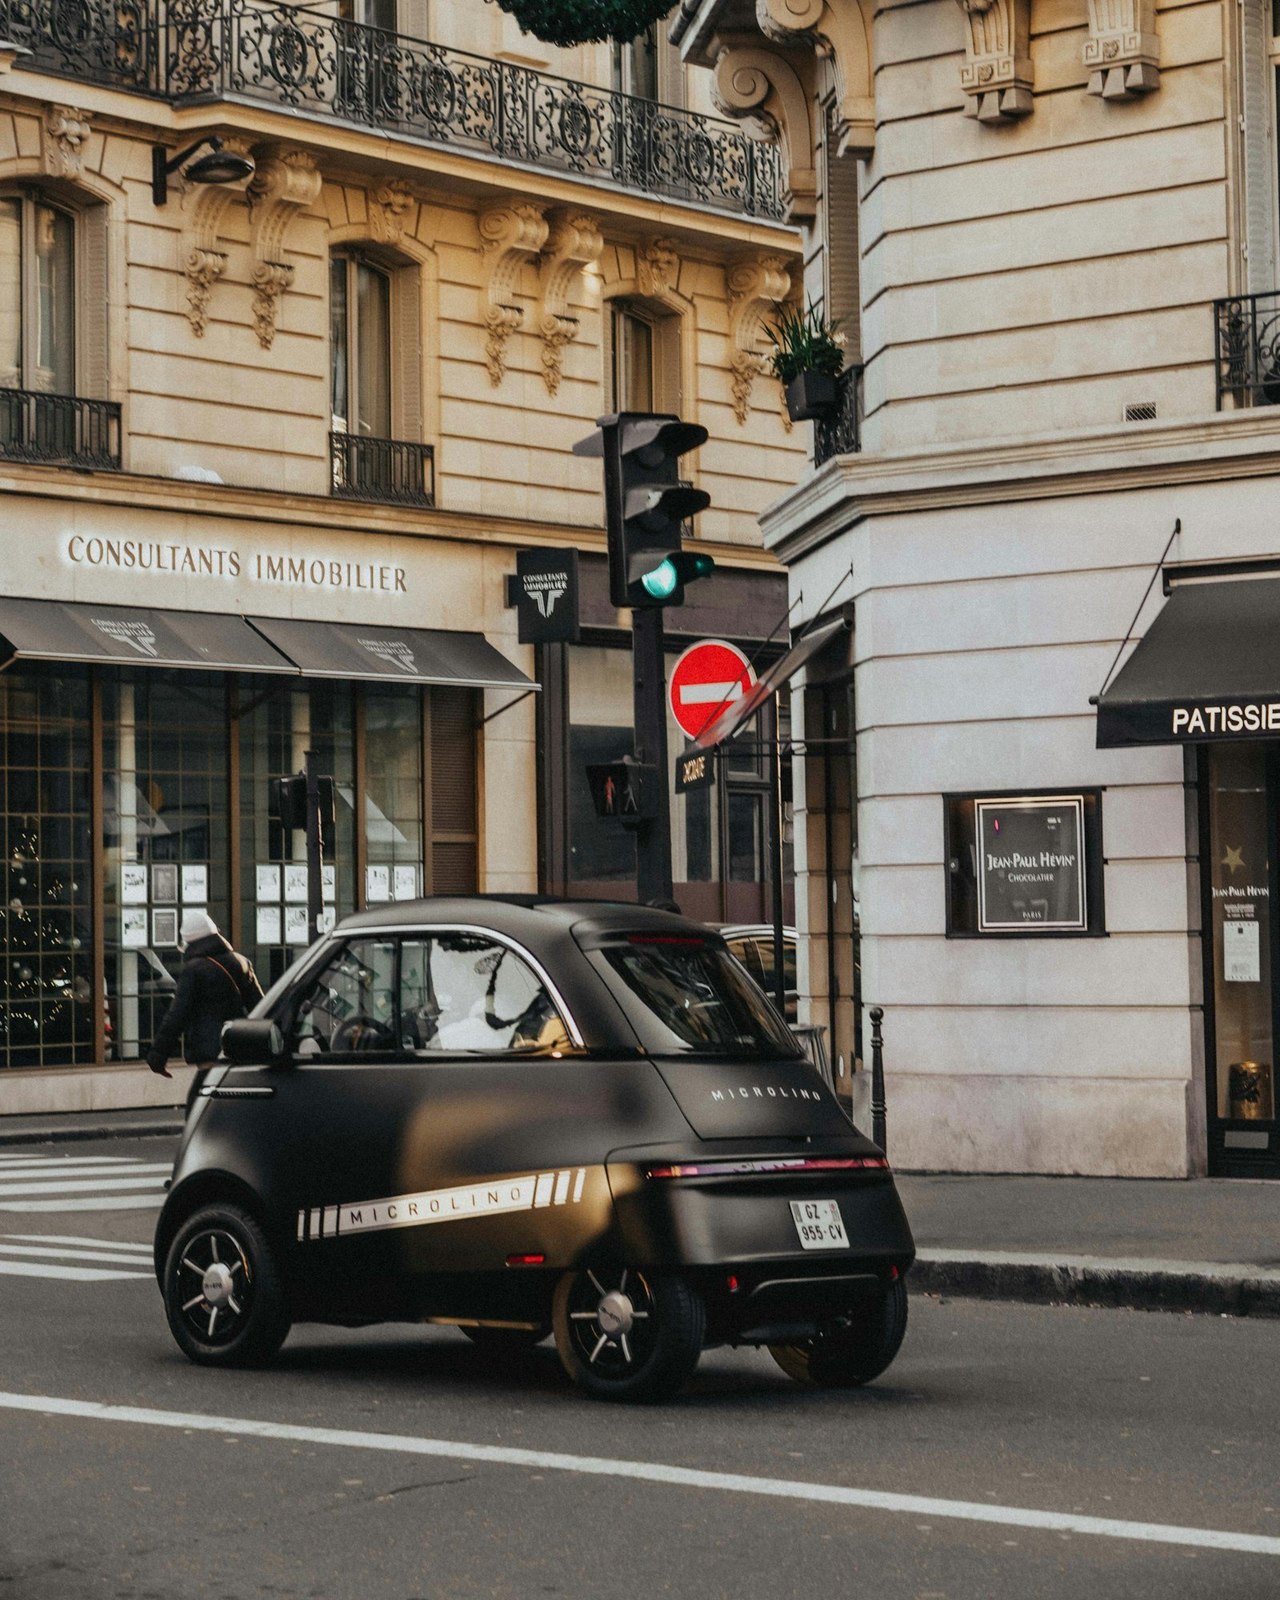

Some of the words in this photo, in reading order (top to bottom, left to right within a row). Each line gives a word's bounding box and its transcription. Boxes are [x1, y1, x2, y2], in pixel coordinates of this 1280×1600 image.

[68, 535, 241, 577] CONSULTANTS
[256, 554, 407, 592] IMMOBILIER
[1172, 703, 1280, 735] PATISSIE
[986, 852, 1038, 871] JEAN-PAUL
[1007, 872, 1055, 883] CHOCOLATIER
[1022, 910, 1042, 919] PARIS
[710, 1085, 821, 1102] MICROLINO
[349, 1186, 522, 1225] MICROLINO
